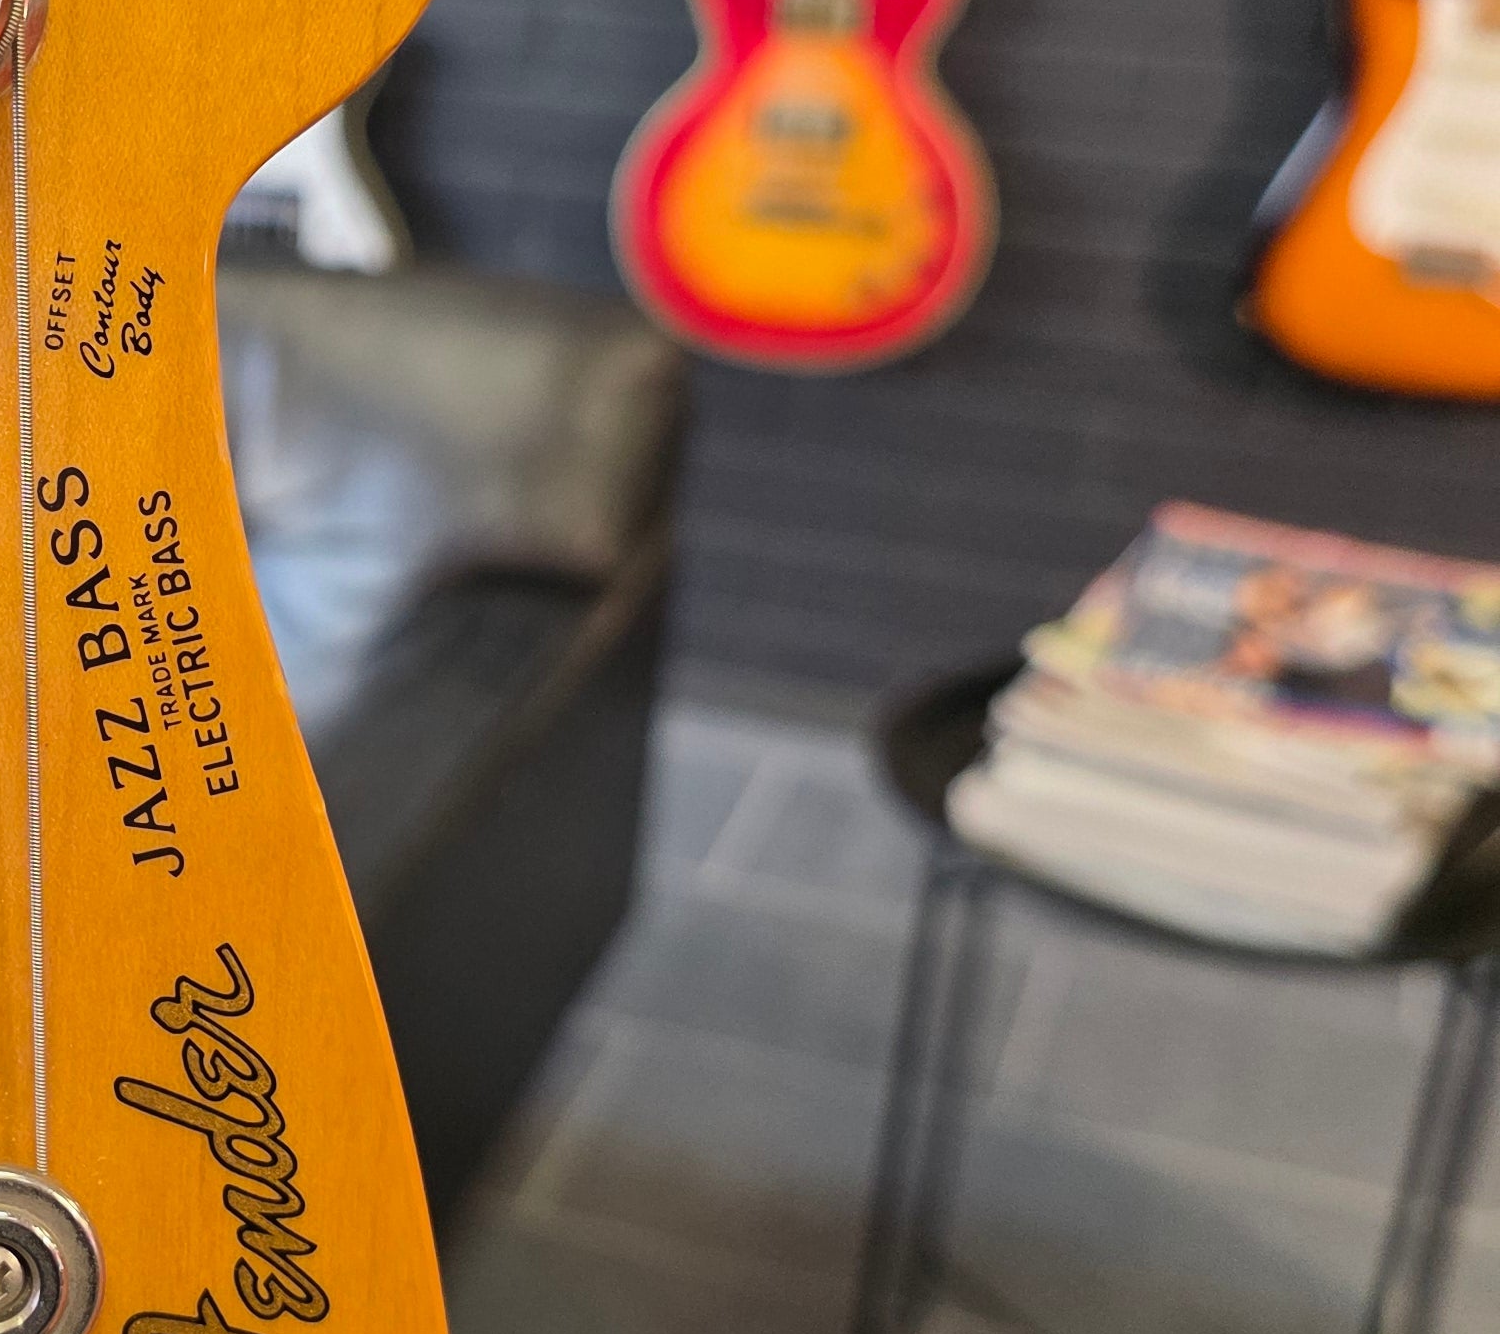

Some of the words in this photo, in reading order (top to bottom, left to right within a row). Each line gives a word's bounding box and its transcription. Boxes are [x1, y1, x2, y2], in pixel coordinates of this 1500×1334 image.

[44, 251, 76, 351] OFFSET
[79, 239, 123, 379] Contour
[120, 266, 166, 356] Body
[36, 466, 132, 672] BASS
[138, 490, 192, 597] BASS
[128, 572, 162, 645] MARK
[147, 651, 183, 731] TRADE
[166, 606, 240, 797] ELECTRIC
[95, 697, 186, 879] JAZZ
